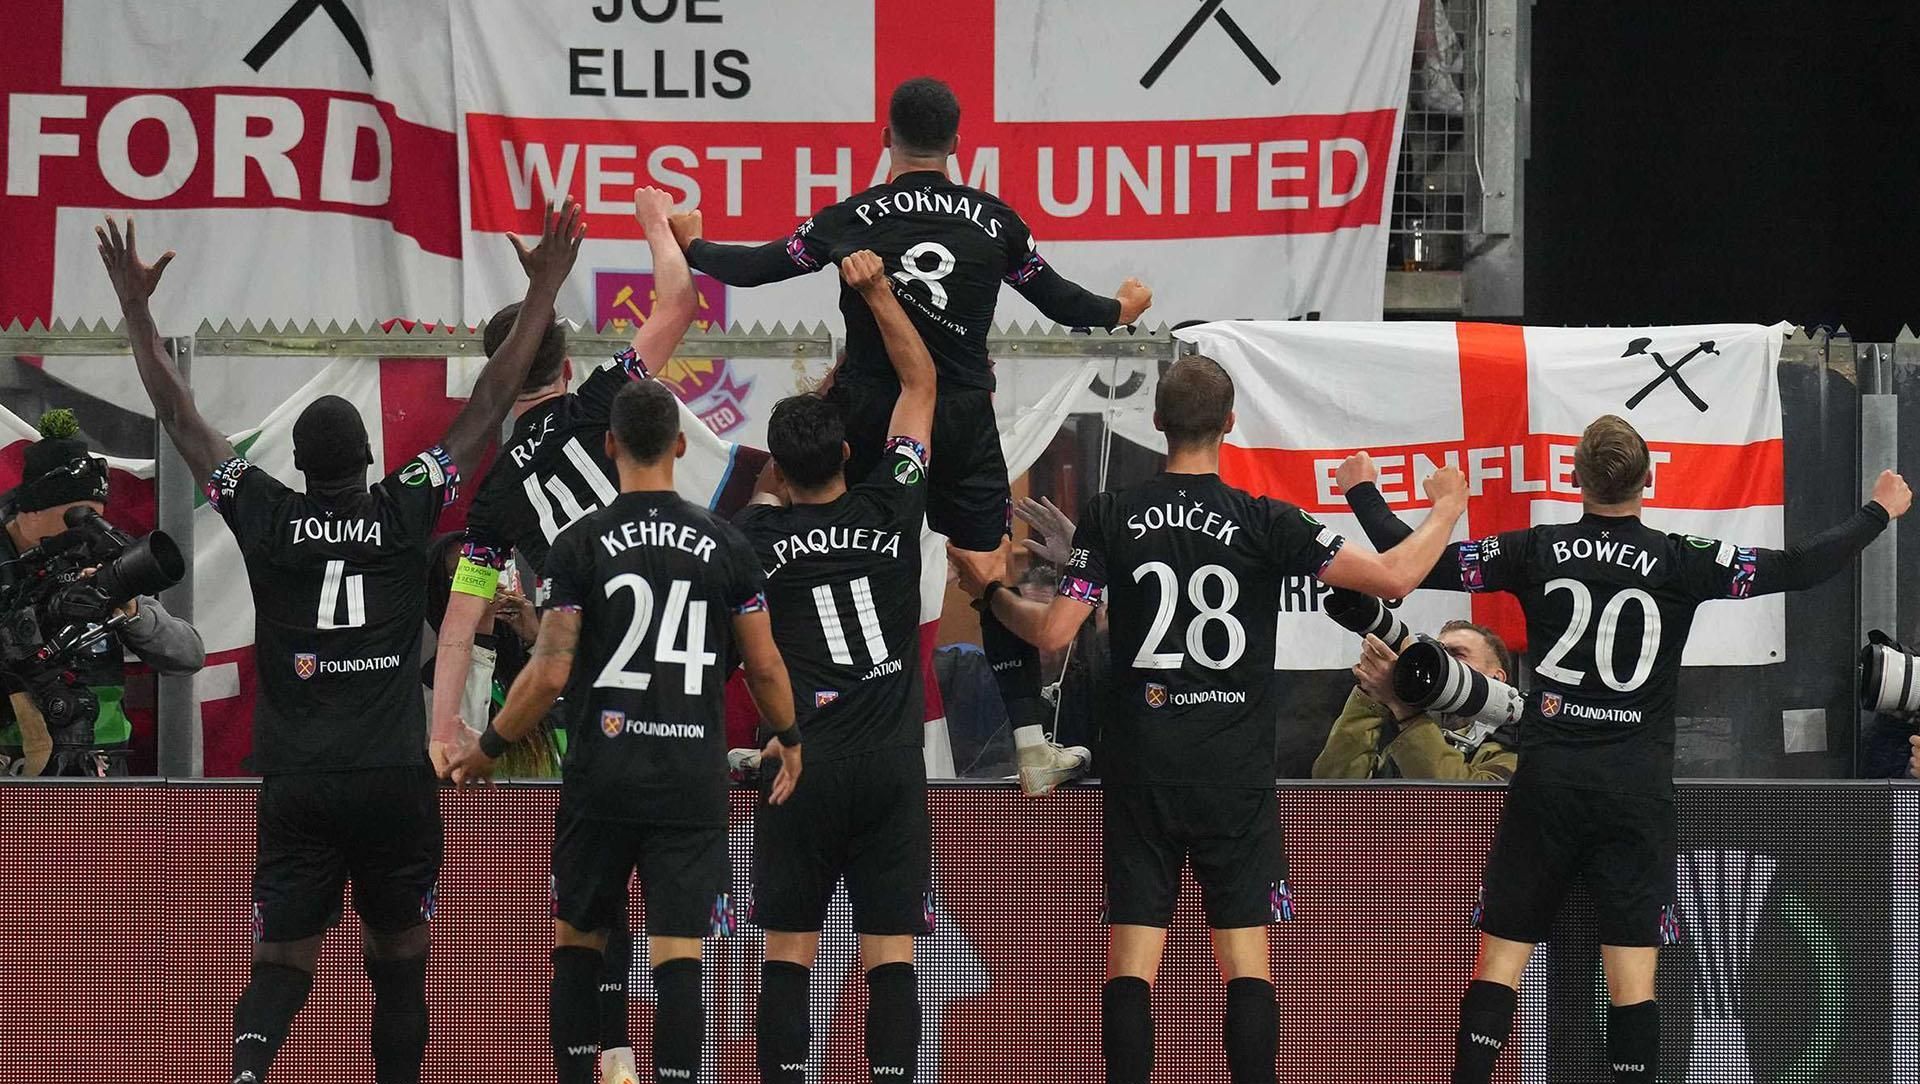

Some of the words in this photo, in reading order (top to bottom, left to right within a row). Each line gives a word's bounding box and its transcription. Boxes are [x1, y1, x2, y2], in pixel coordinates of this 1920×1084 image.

[569, 48, 751, 99] ELLIS
[6, 93, 393, 207] FORD
[501, 139, 762, 217] WEST
[795, 147, 999, 217] HM
[1037, 138, 1369, 218] UNITED
[855, 190, 1003, 239] P.FORNALS
[892, 241, 956, 311] 8
[522, 436, 619, 547] 41
[1314, 445, 1672, 505] BENFLET
[289, 516, 382, 547] ZOUMA
[600, 520, 718, 563] KEHRER
[1127, 501, 1241, 547] SOUČEK
[763, 526, 902, 580] L.PAQUETÁ
[1552, 538, 1659, 577] BOWEN
[317, 560, 367, 630] 4
[1131, 561, 1247, 670] 28
[592, 573, 717, 696] 24
[811, 575, 890, 666] 11
[1535, 578, 1662, 693] 20
[320, 654, 400, 674] FOUNDATION
[992, 659, 1022, 672] WHU
[1169, 690, 1247, 706] FOUNDATION
[1563, 702, 1642, 724] FOUNDATION
[626, 719, 704, 739] FOUNDATION
[568, 1044, 598, 1056] WHU
[1470, 1032, 1502, 1050] WHU
[659, 1067, 690, 1079] WHU
[873, 1066, 904, 1076] WHU
[1613, 1063, 1645, 1072] WHU
